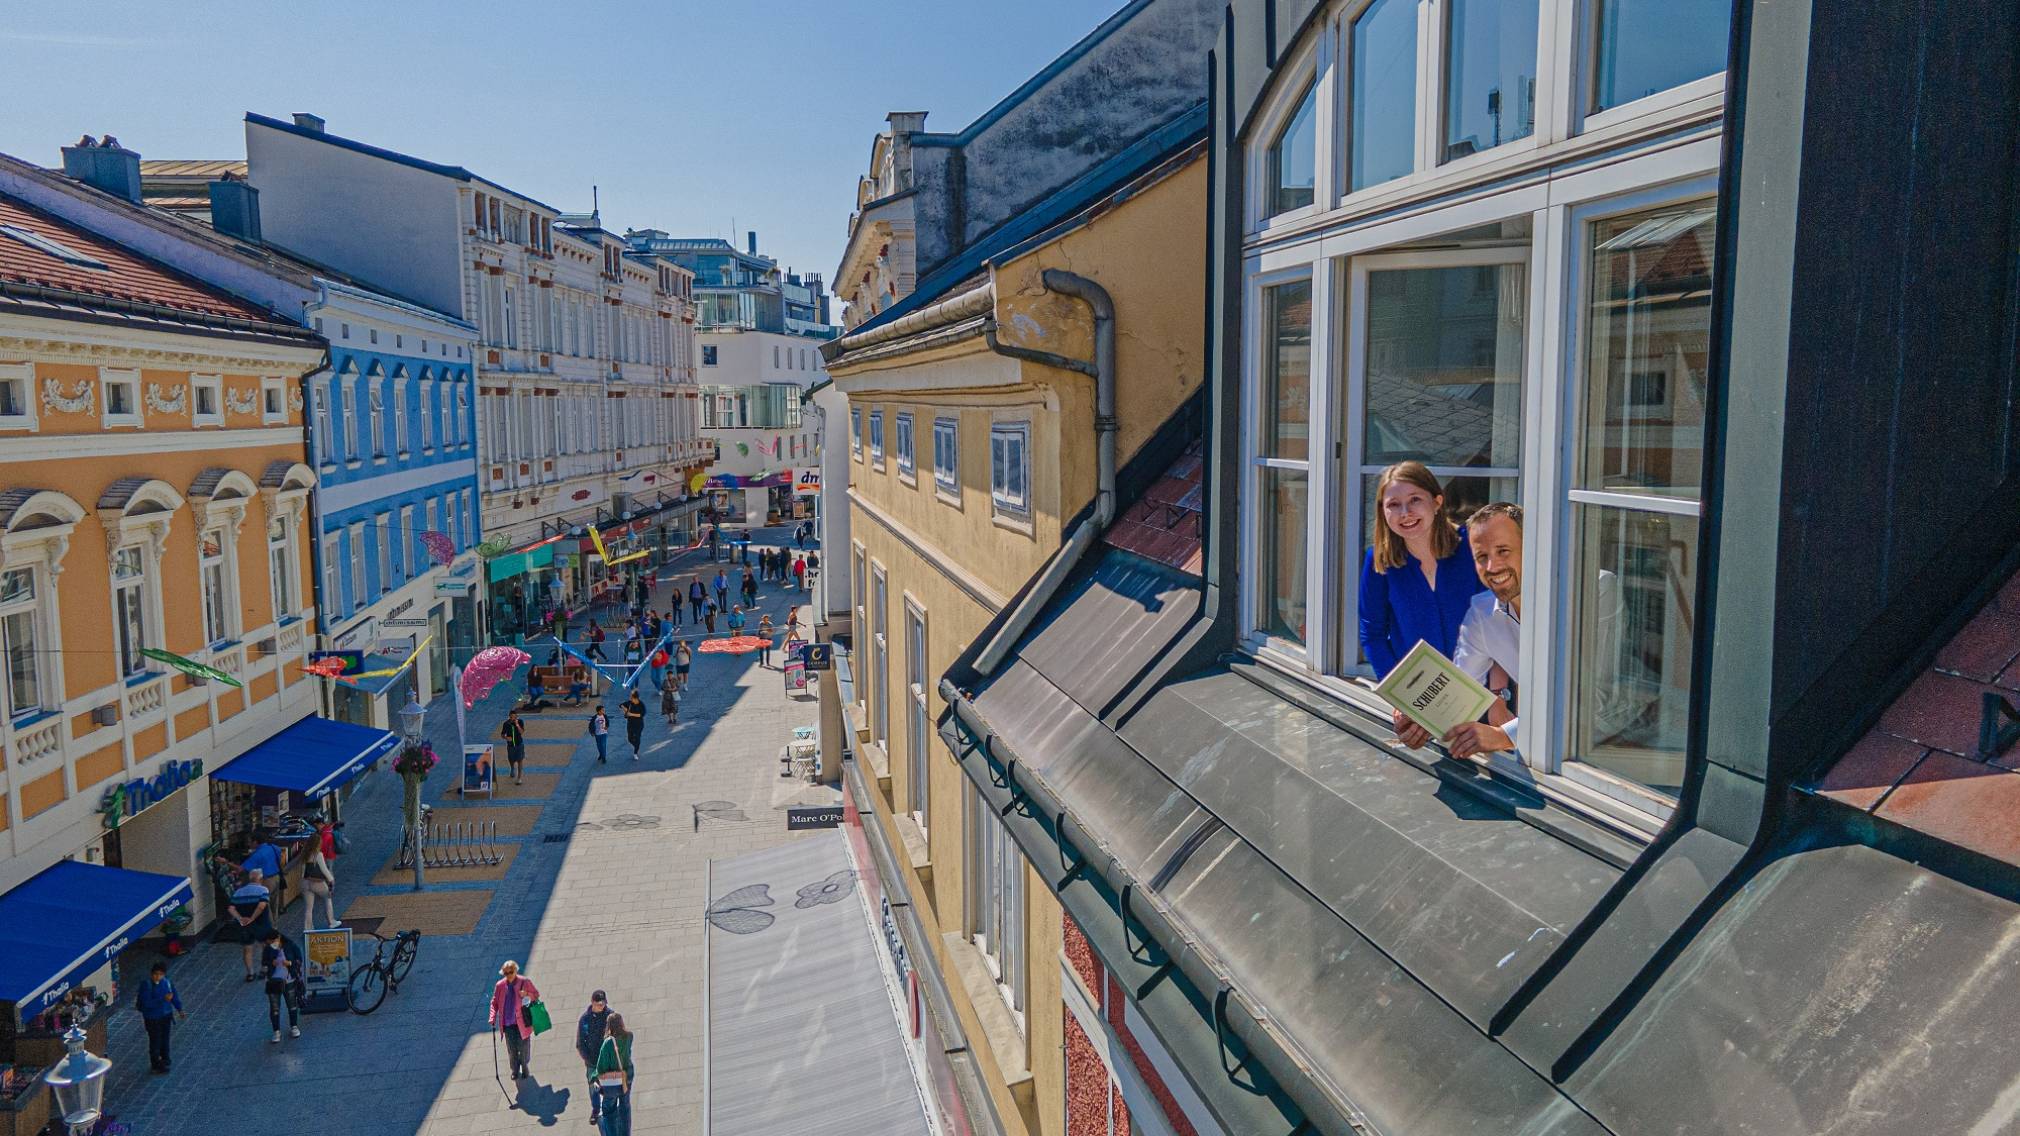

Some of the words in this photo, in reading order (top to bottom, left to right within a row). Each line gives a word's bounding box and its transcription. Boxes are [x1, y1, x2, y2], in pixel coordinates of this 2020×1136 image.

[1412, 671, 1451, 711] SCHUBERT
[124, 758, 195, 817] Thalia
[791, 815, 818, 823] Marc
[819, 814, 844, 822] O'Po
[163, 899, 180, 916] Thalia
[109, 937, 129, 955] Thalia
[49, 981, 70, 1001] Thalia
